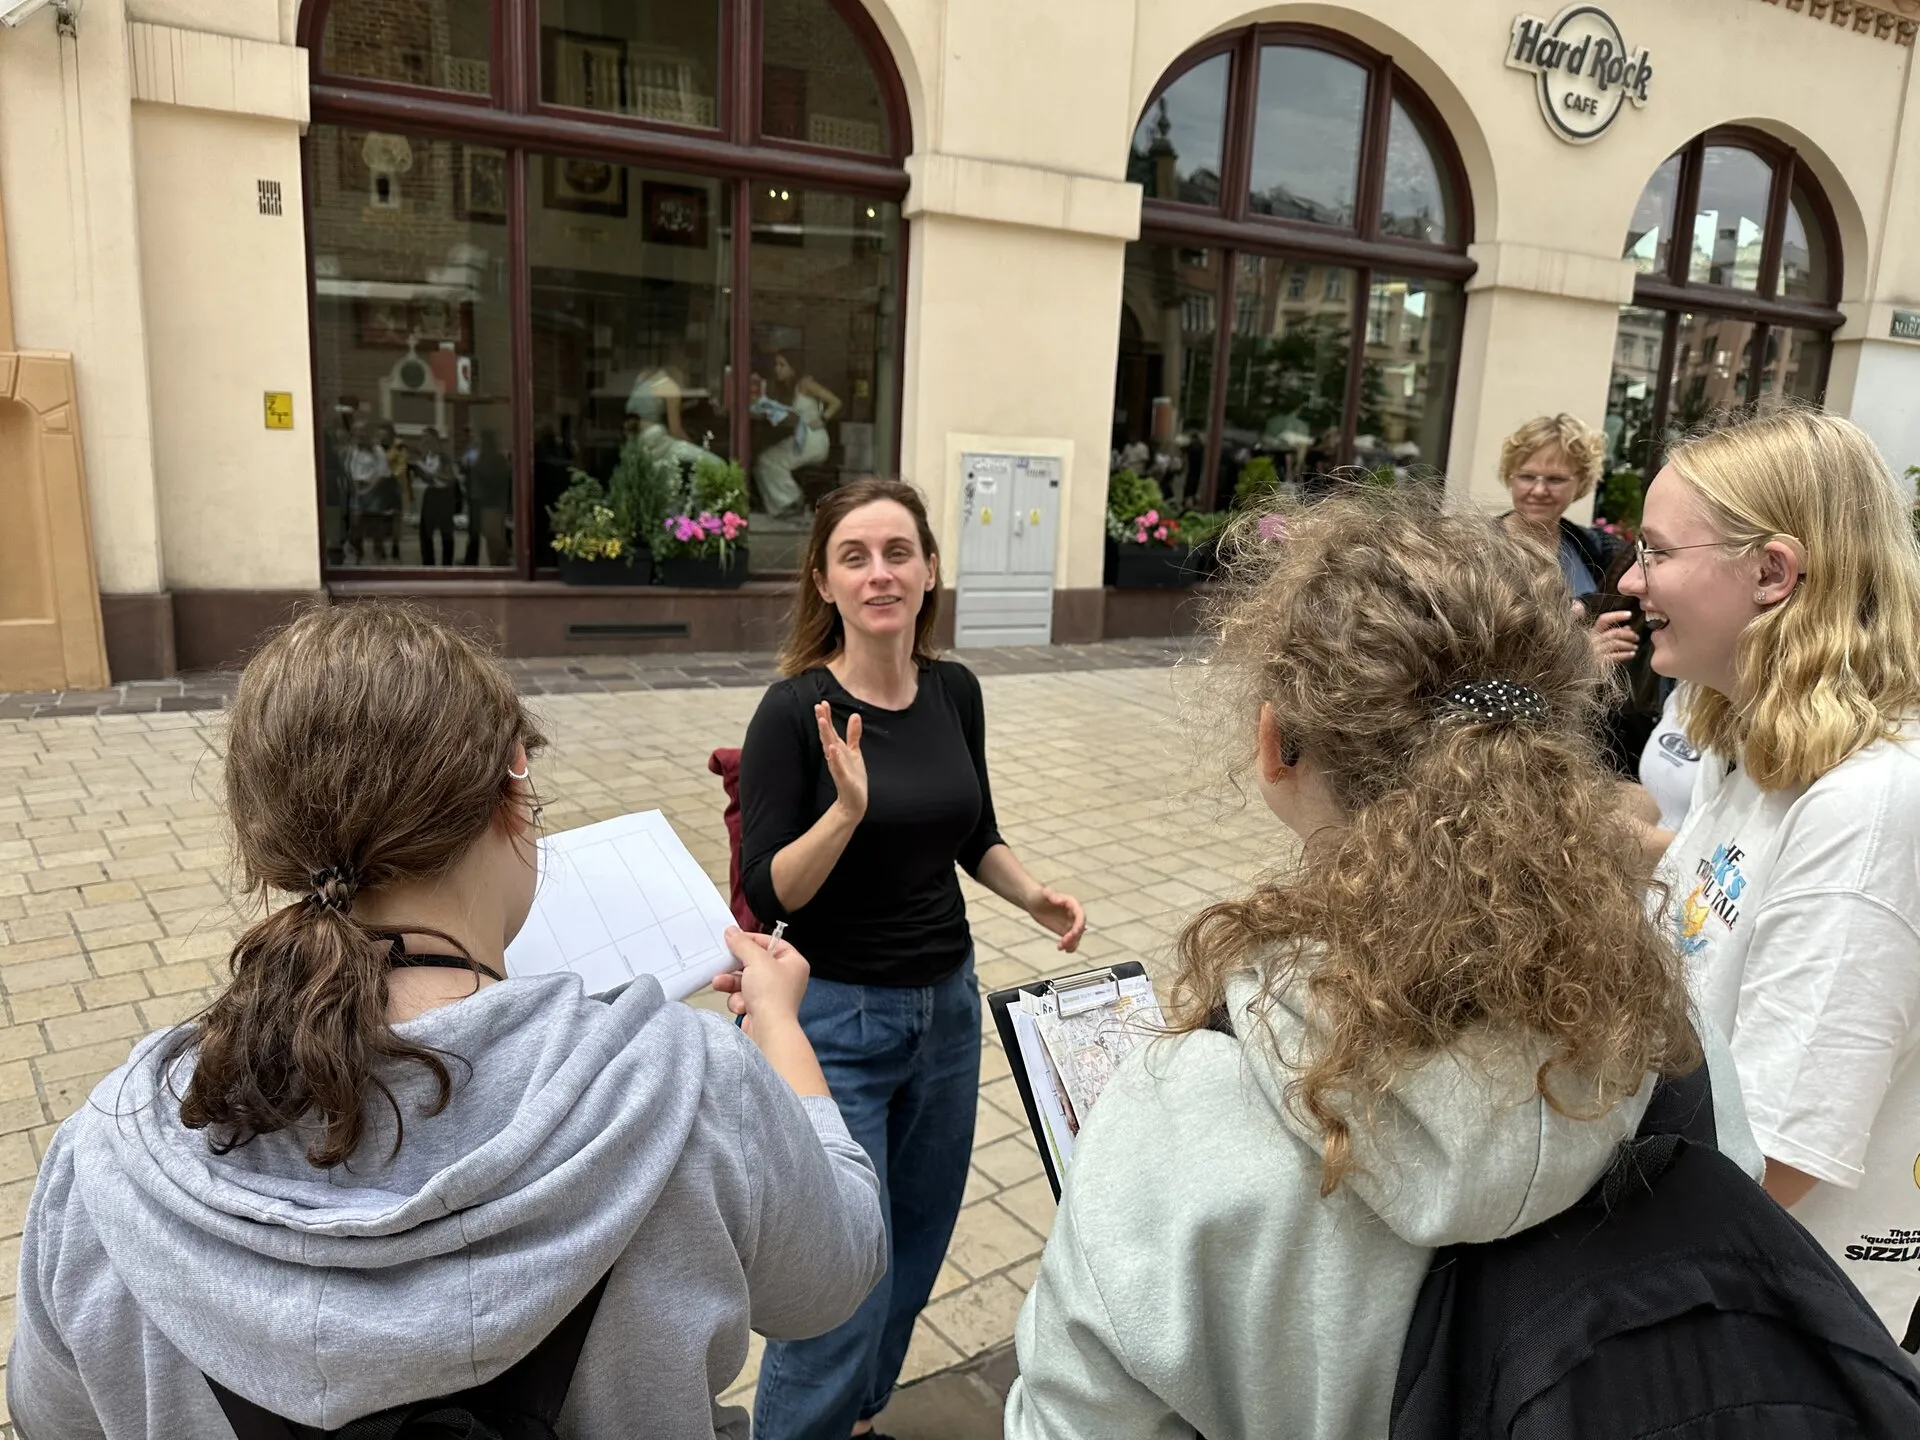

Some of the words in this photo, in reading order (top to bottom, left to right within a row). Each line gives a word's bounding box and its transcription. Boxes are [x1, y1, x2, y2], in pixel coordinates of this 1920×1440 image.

[1515, 19, 1591, 75] Hard
[1588, 38, 1652, 101] Rock
[1564, 92, 1599, 116] CAFE
[1889, 1229, 1911, 1237] The
